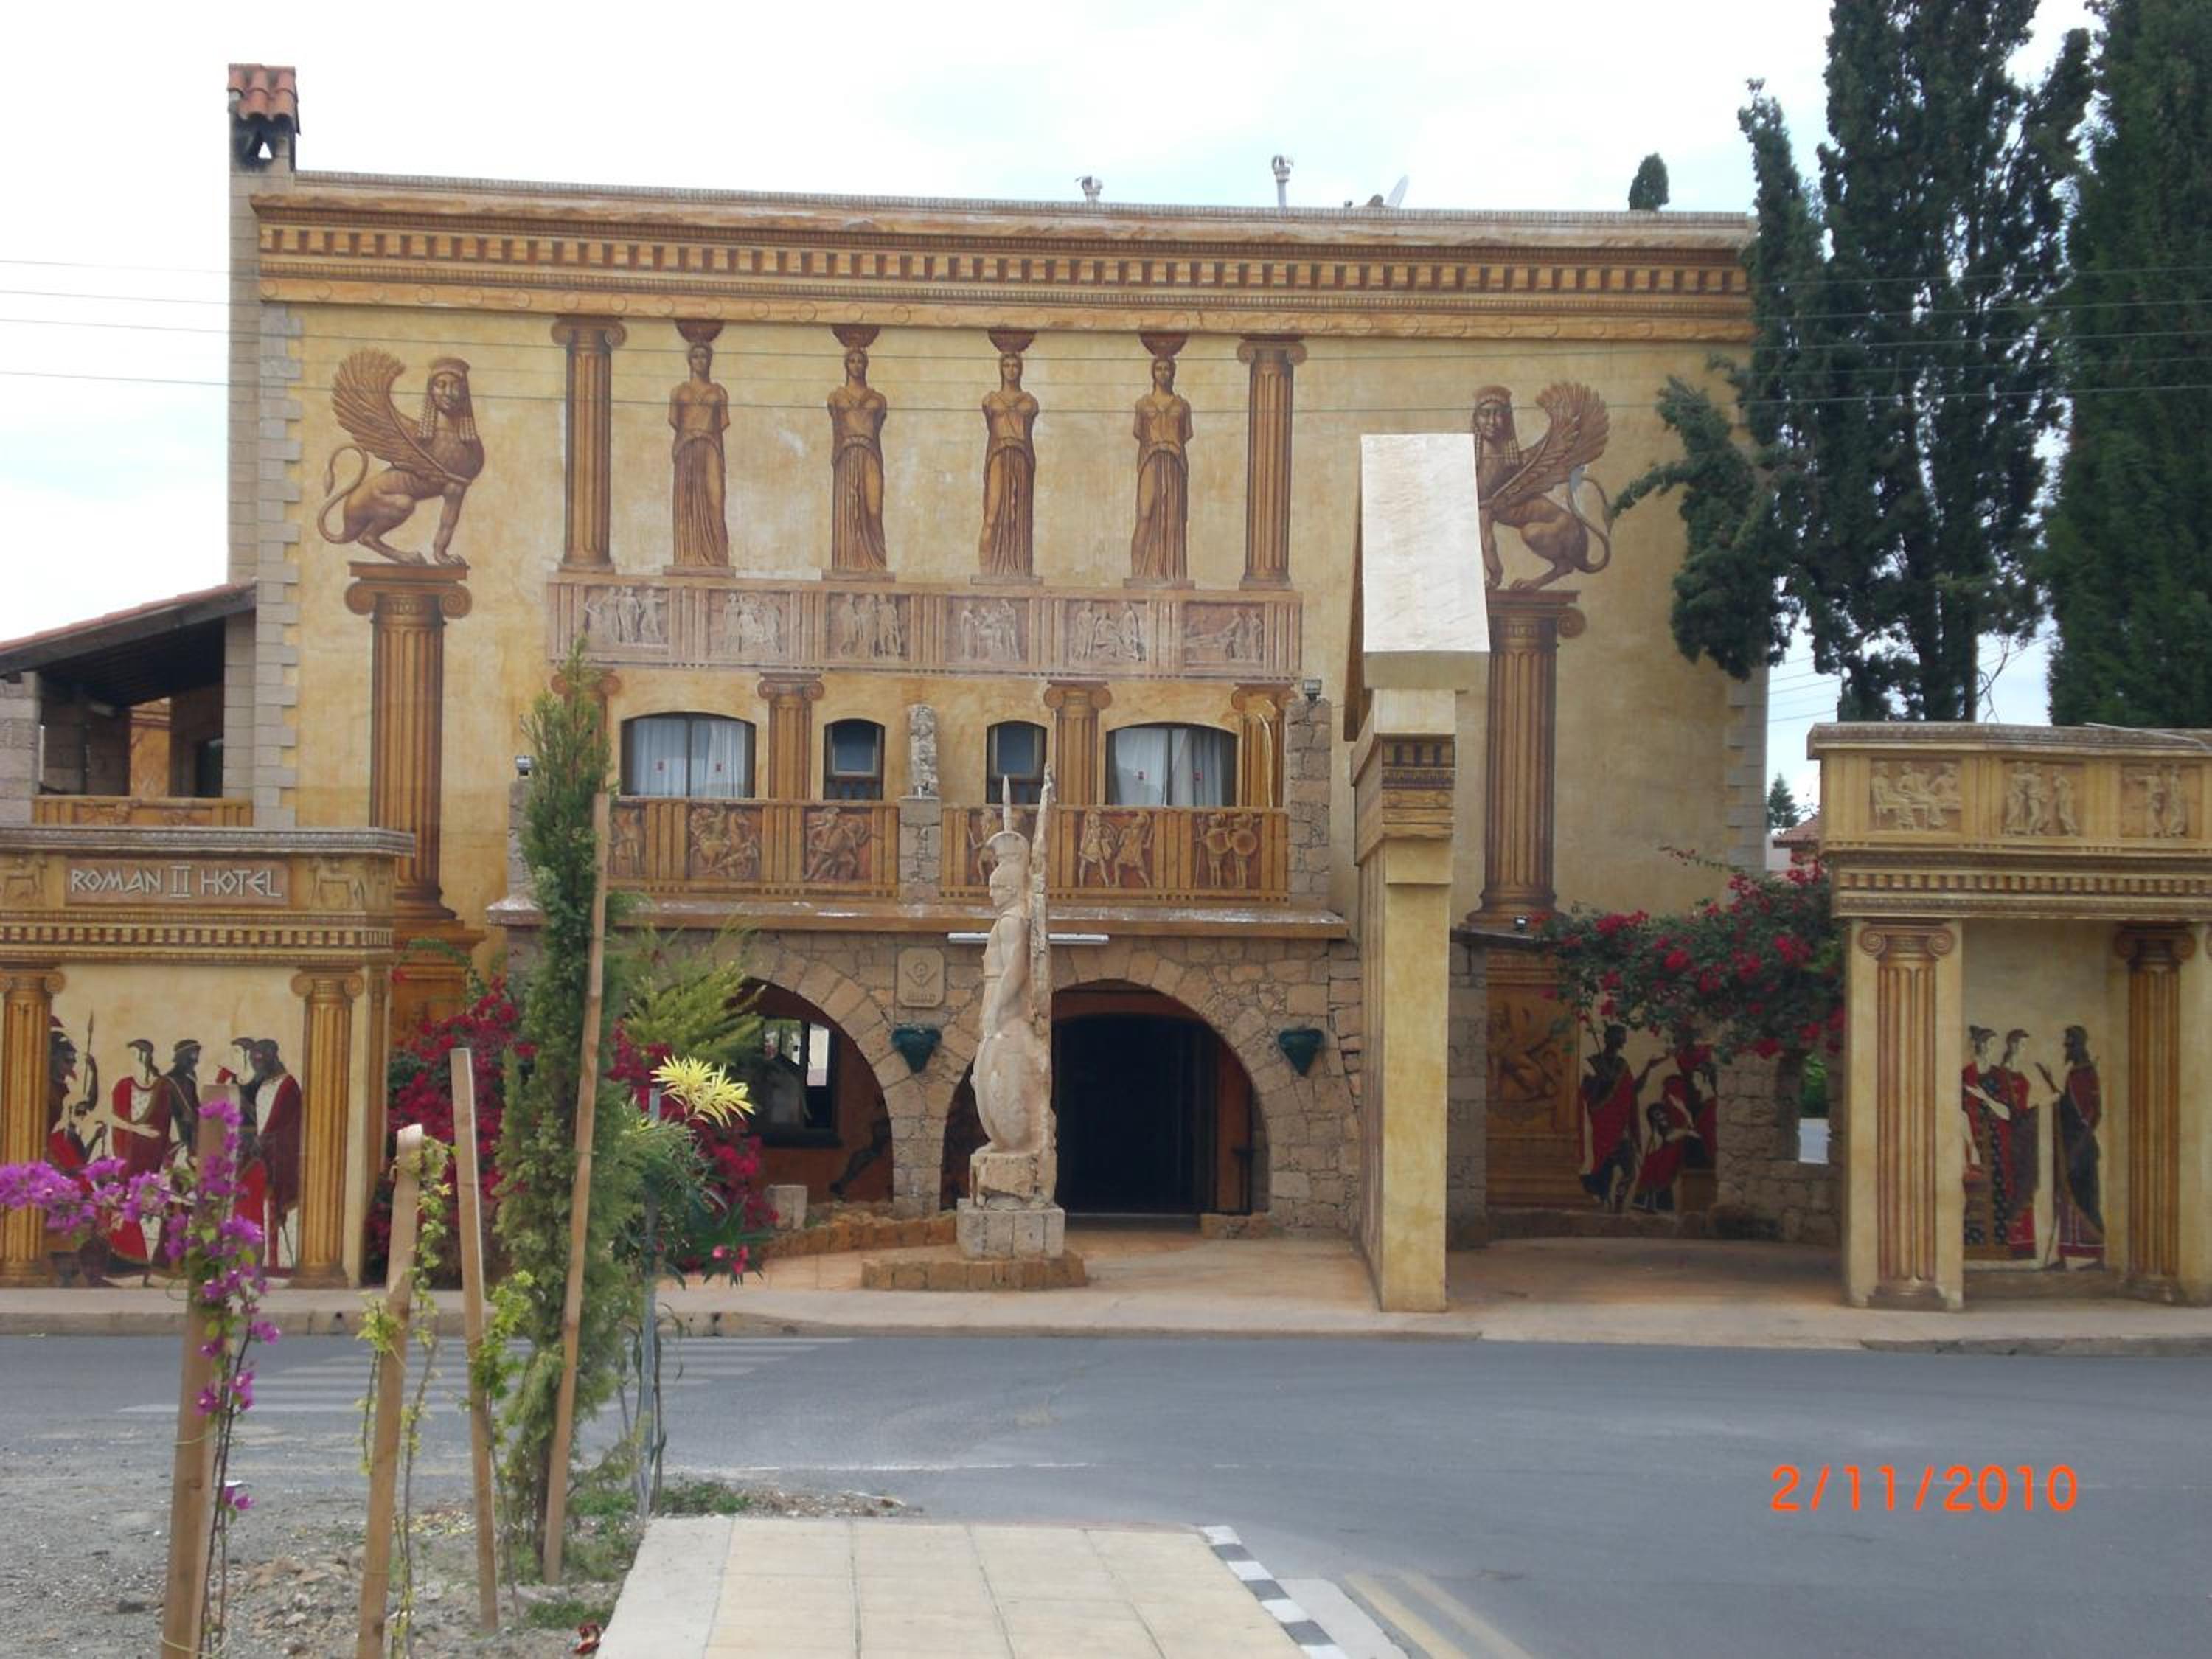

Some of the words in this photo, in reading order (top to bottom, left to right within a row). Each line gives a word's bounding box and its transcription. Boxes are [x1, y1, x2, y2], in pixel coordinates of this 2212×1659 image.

[71, 869, 161, 894] ROMAN
[170, 866, 191, 897] II
[201, 869, 282, 897] HOTEL
